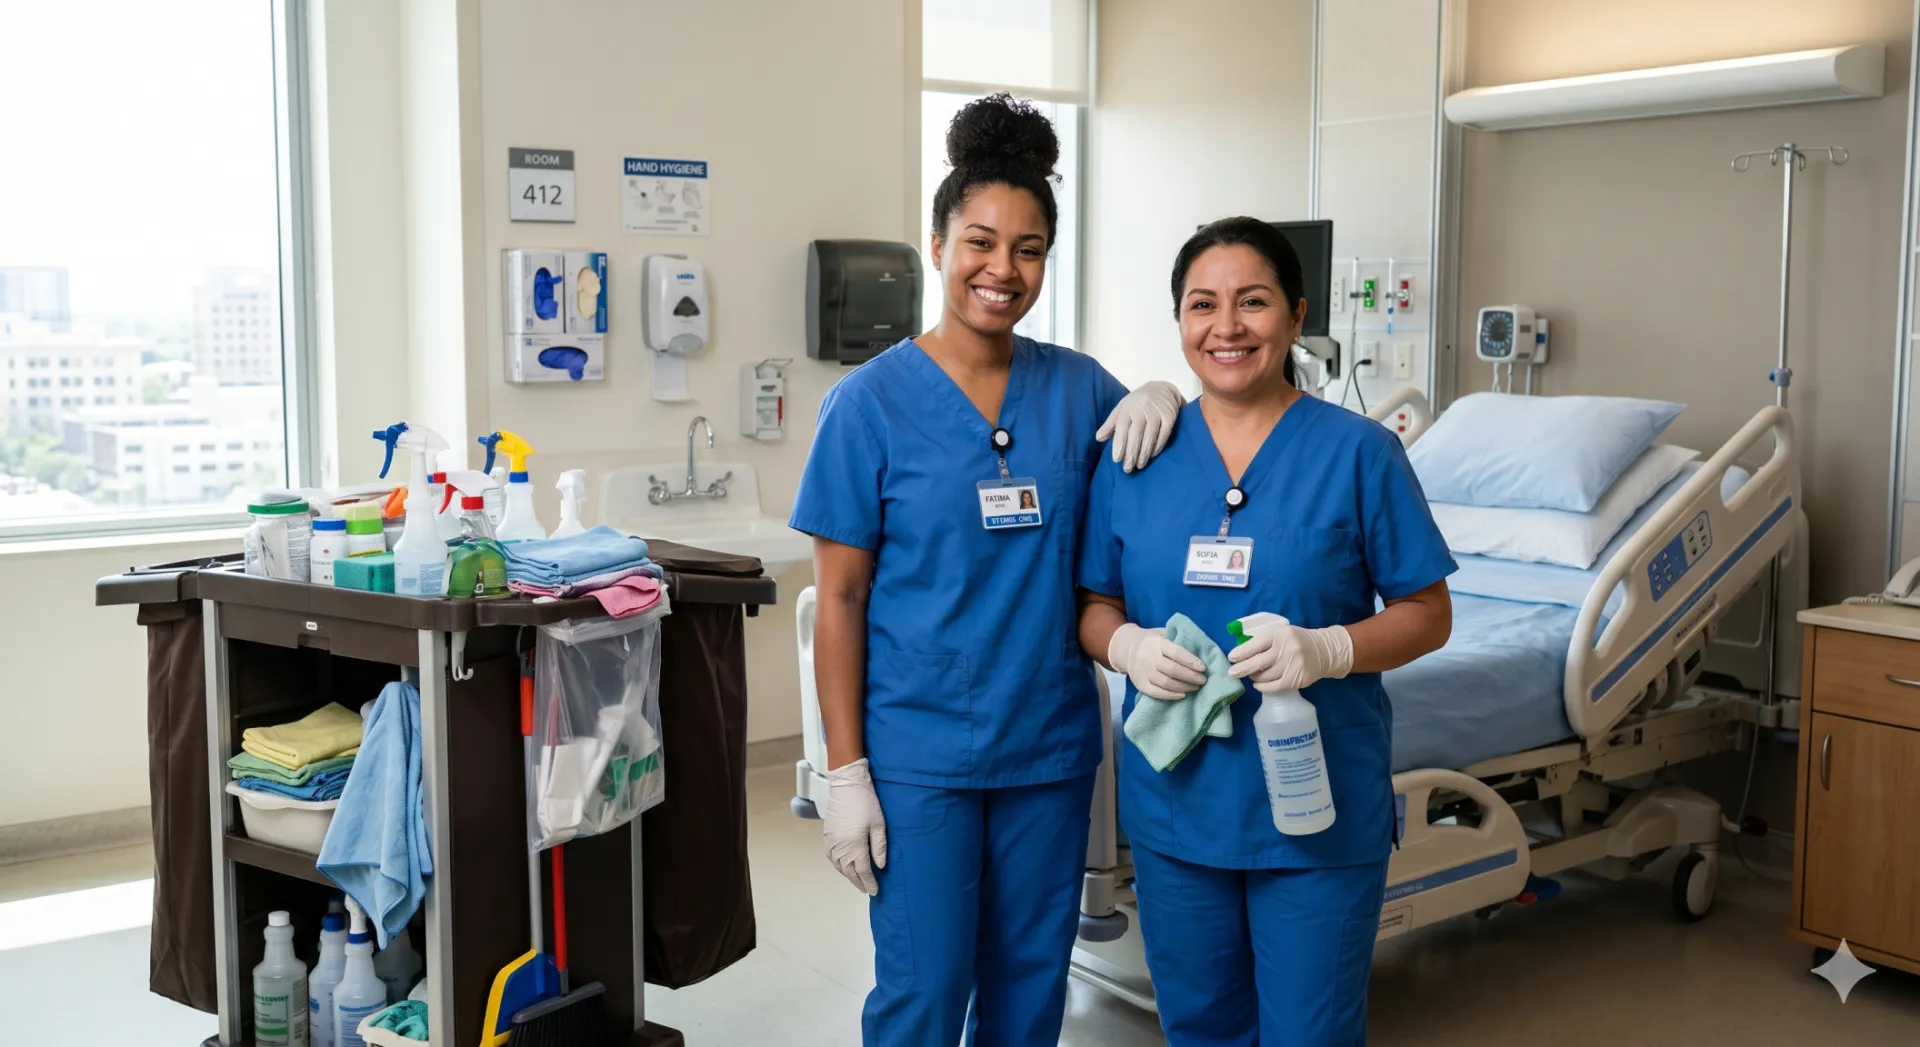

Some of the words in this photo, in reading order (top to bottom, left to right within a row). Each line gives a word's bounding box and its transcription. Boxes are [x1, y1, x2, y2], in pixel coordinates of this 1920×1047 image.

[524, 154, 560, 166] ROOM
[626, 161, 658, 174] HAND
[660, 163, 705, 176] HYGIENE
[523, 184, 562, 206] 412
[985, 494, 1011, 503] FATIMA
[1196, 551, 1218, 559] SOFIA
